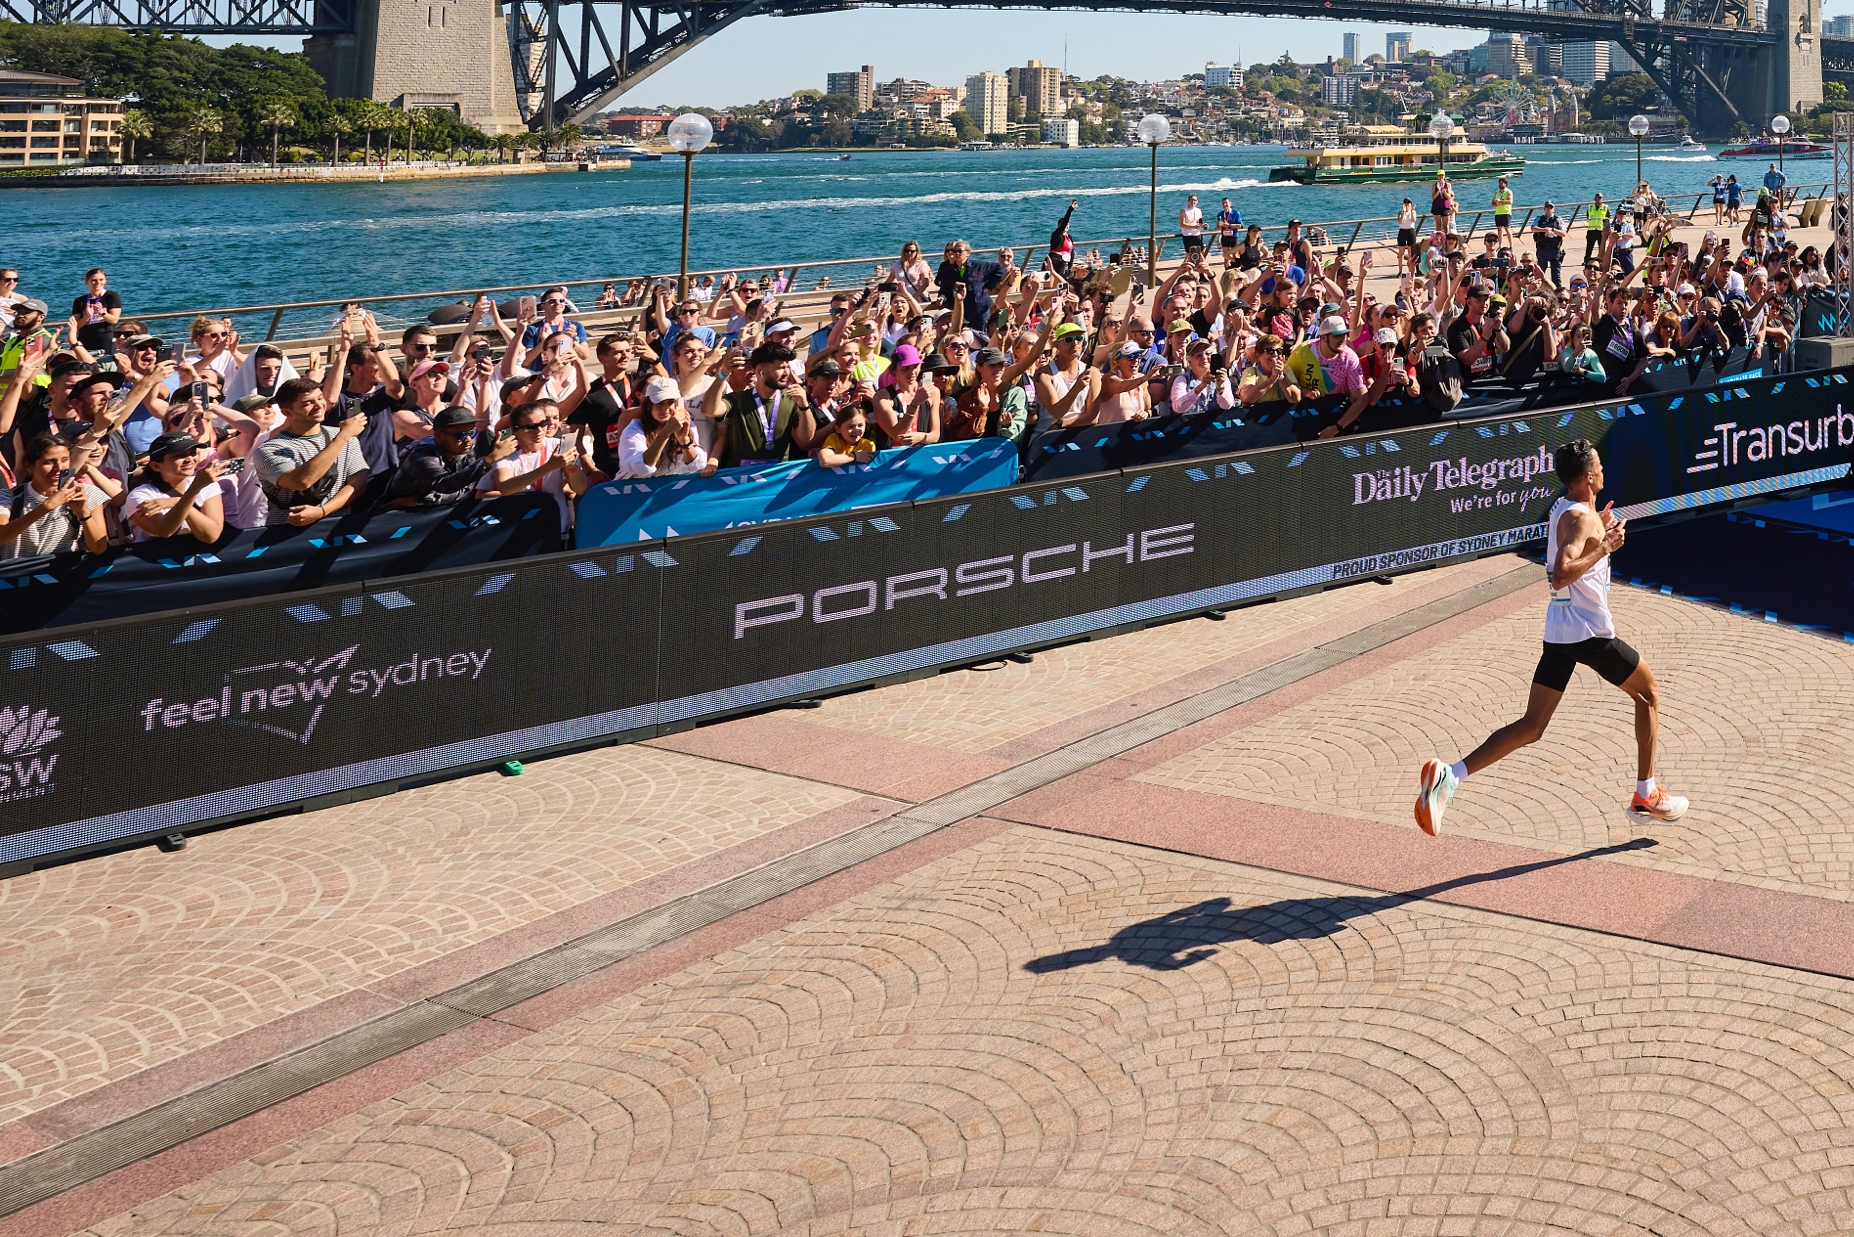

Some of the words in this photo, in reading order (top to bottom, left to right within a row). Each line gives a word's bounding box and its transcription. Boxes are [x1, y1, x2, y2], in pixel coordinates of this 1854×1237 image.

[1352, 464, 1428, 506] Daily
[1430, 444, 1556, 490] Telegraph
[1450, 494, 1493, 514] We're
[1496, 490, 1516, 506] for
[1519, 486, 1555, 512] you
[734, 522, 1195, 640] PORSCHE
[1334, 557, 1378, 580] PROUD
[1379, 547, 1438, 570] SPONSOR
[1440, 542, 1455, 557] OF
[1458, 532, 1505, 555] SYDNEY
[1507, 523, 1549, 544] MARAT
[140, 685, 231, 732] feel
[240, 675, 339, 714] new
[348, 648, 492, 698] sydney
